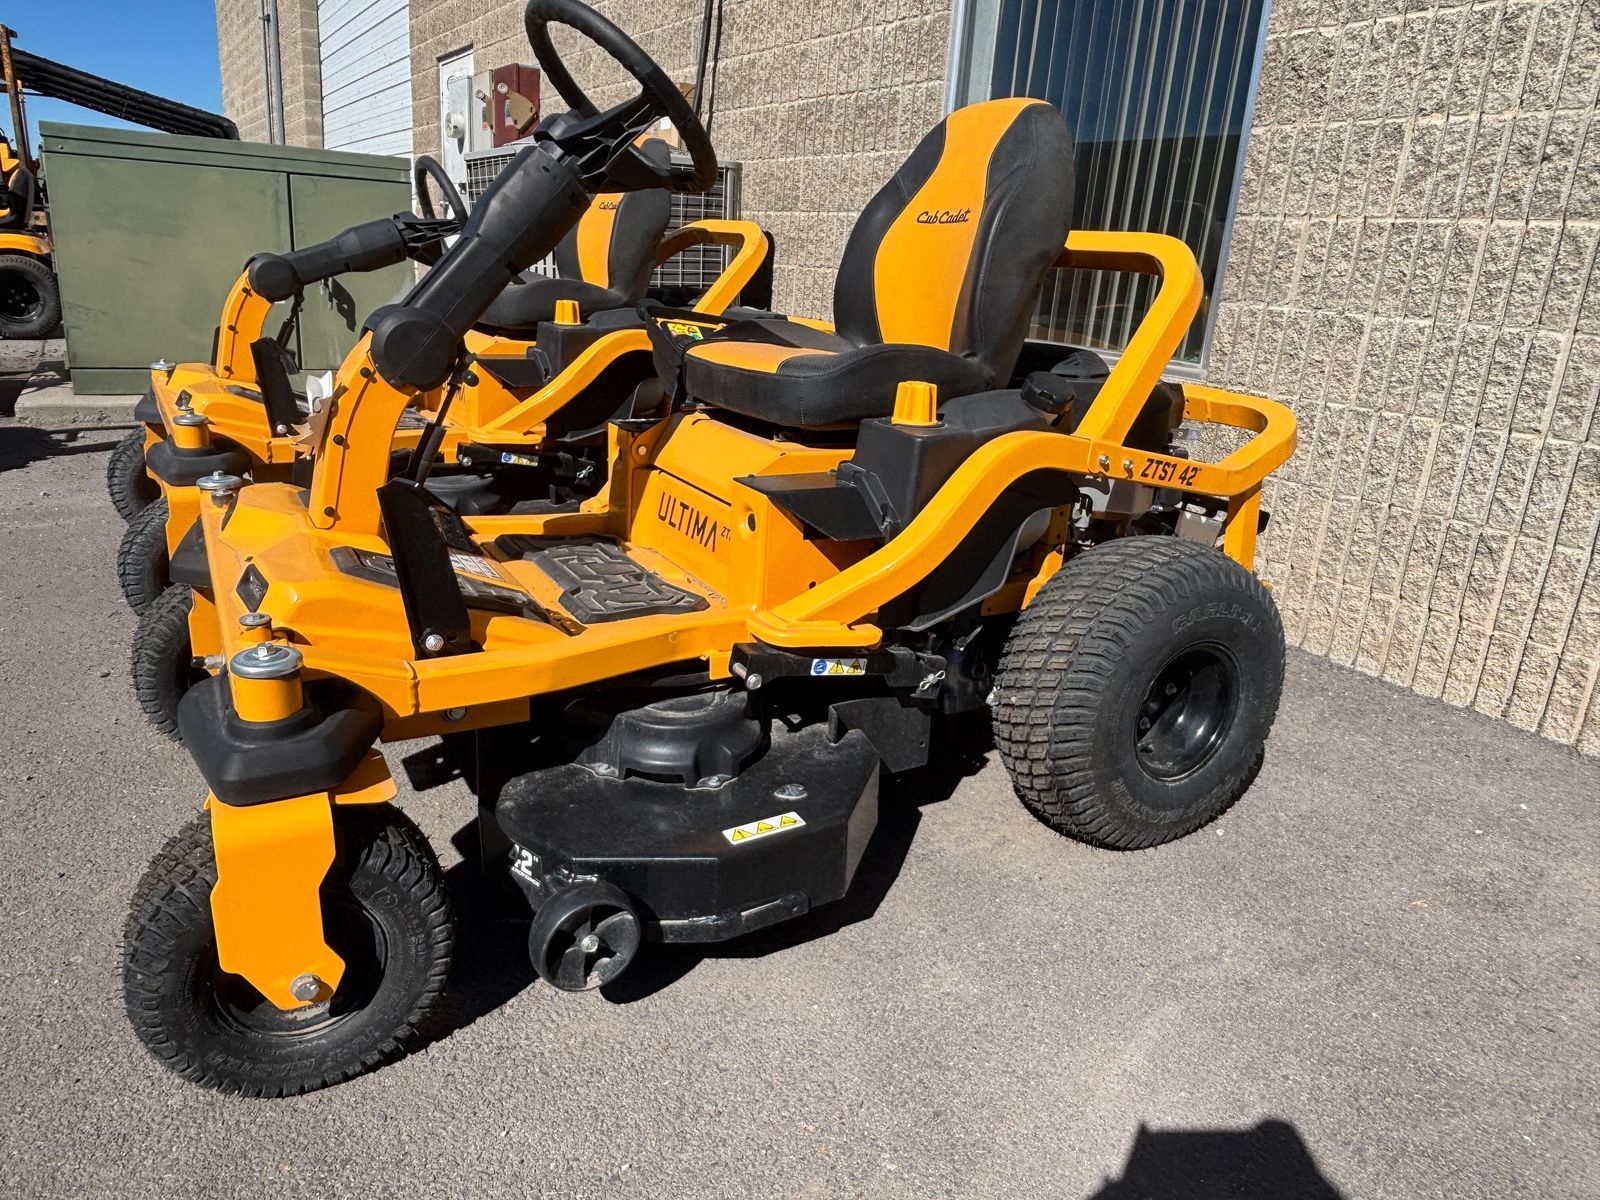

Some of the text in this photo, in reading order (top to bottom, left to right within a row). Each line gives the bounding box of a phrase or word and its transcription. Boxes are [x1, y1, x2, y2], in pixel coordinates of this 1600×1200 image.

[916, 207, 972, 224] Cub Cadet
[1140, 458, 1178, 482] ZTS1
[658, 491, 718, 553] ULTIMA
